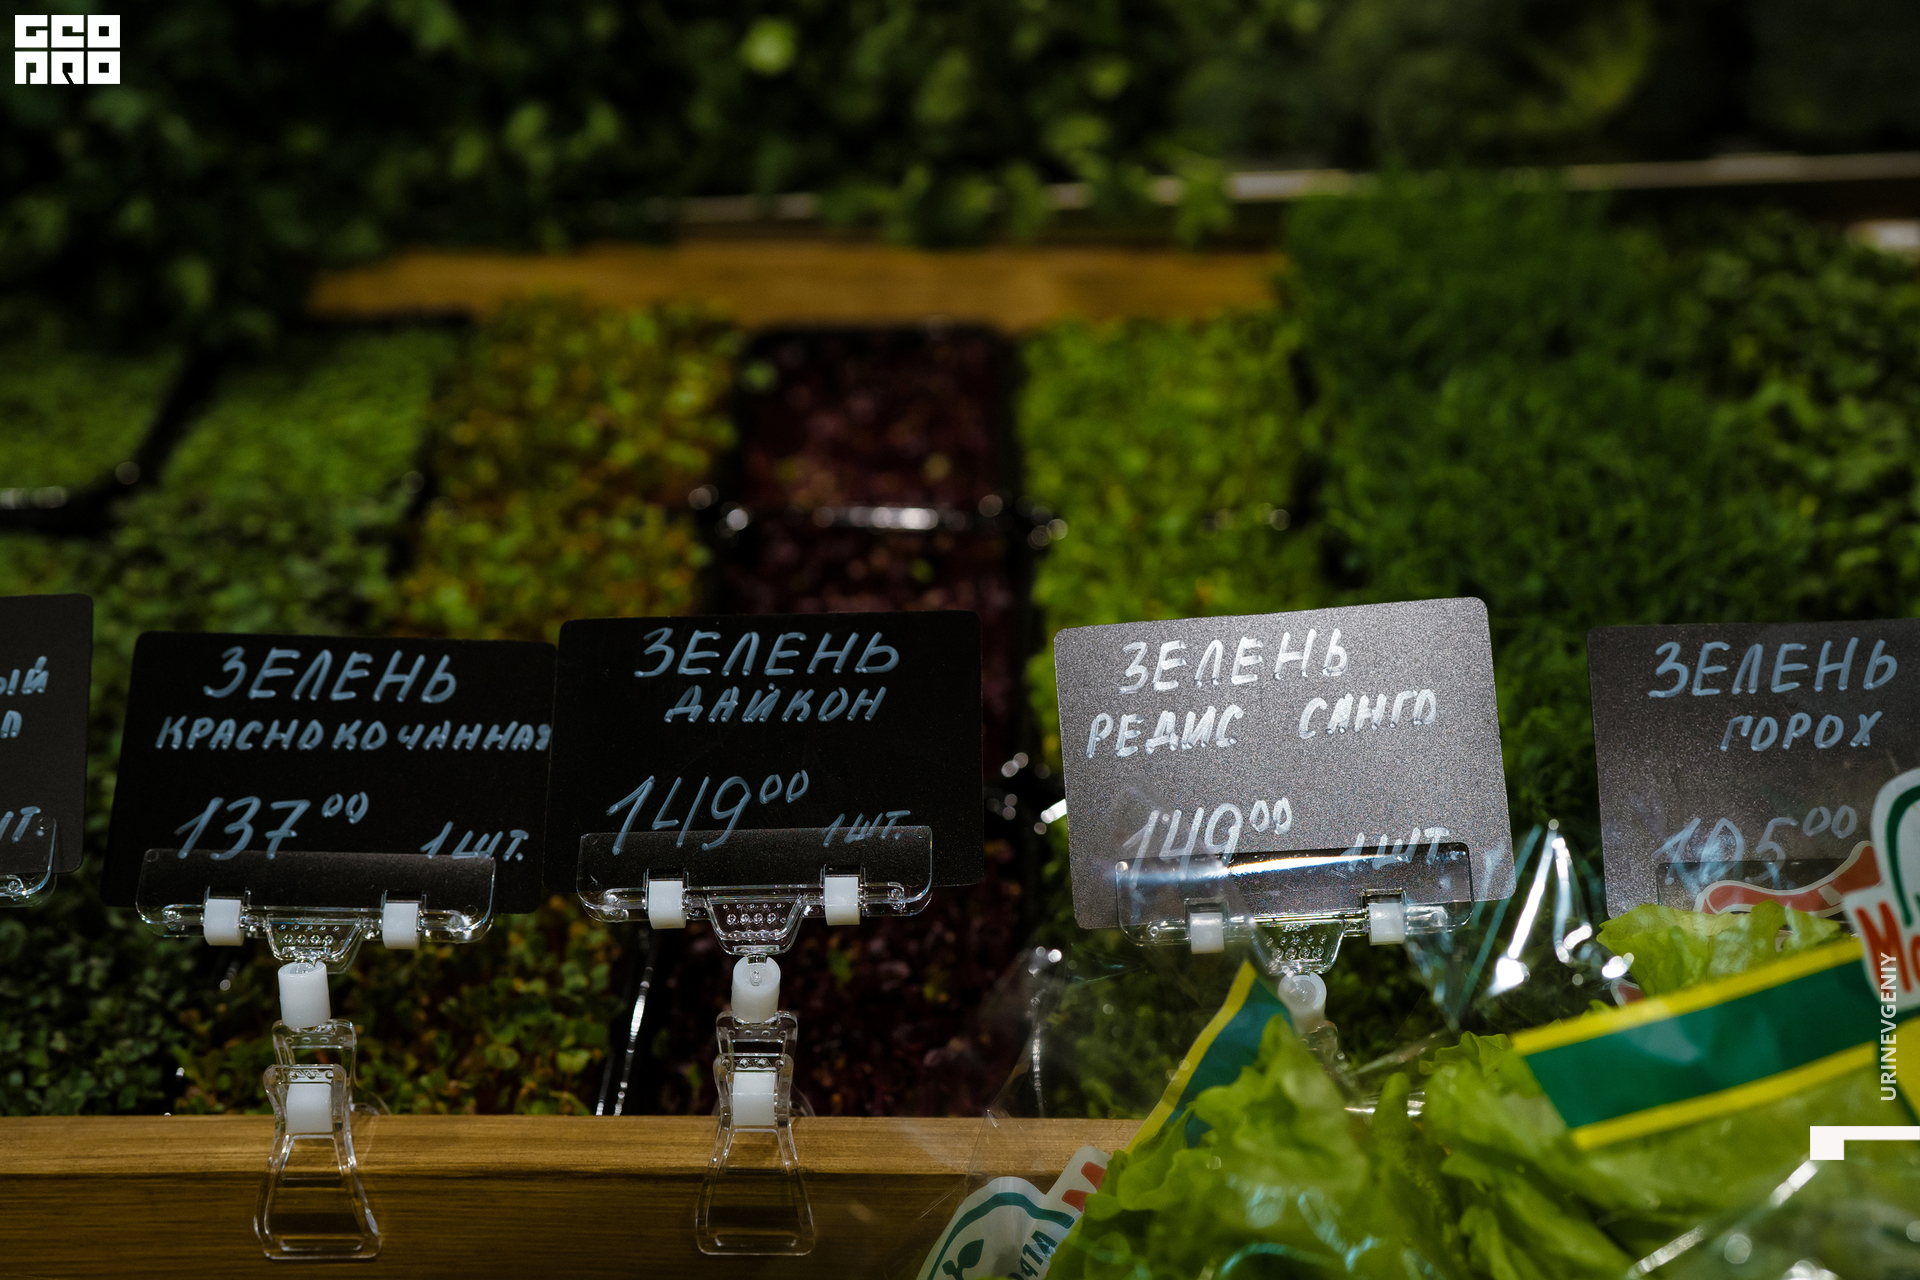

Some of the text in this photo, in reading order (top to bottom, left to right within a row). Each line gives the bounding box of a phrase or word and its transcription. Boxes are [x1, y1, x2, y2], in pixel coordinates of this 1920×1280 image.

[203, 646, 456, 702] ЗЕЛЕНЬ
[634, 627, 899, 677] ЗЕЛЕНЬ
[1118, 628, 1349, 695] ЗЕЛЕНЬ
[1648, 637, 1898, 698] ЗЕЛЕНЬ
[664, 683, 886, 722] ДАЙКОН
[1087, 689, 1438, 759] РЕДИС САНГО
[1720, 711, 1883, 751] ГОРОХ
